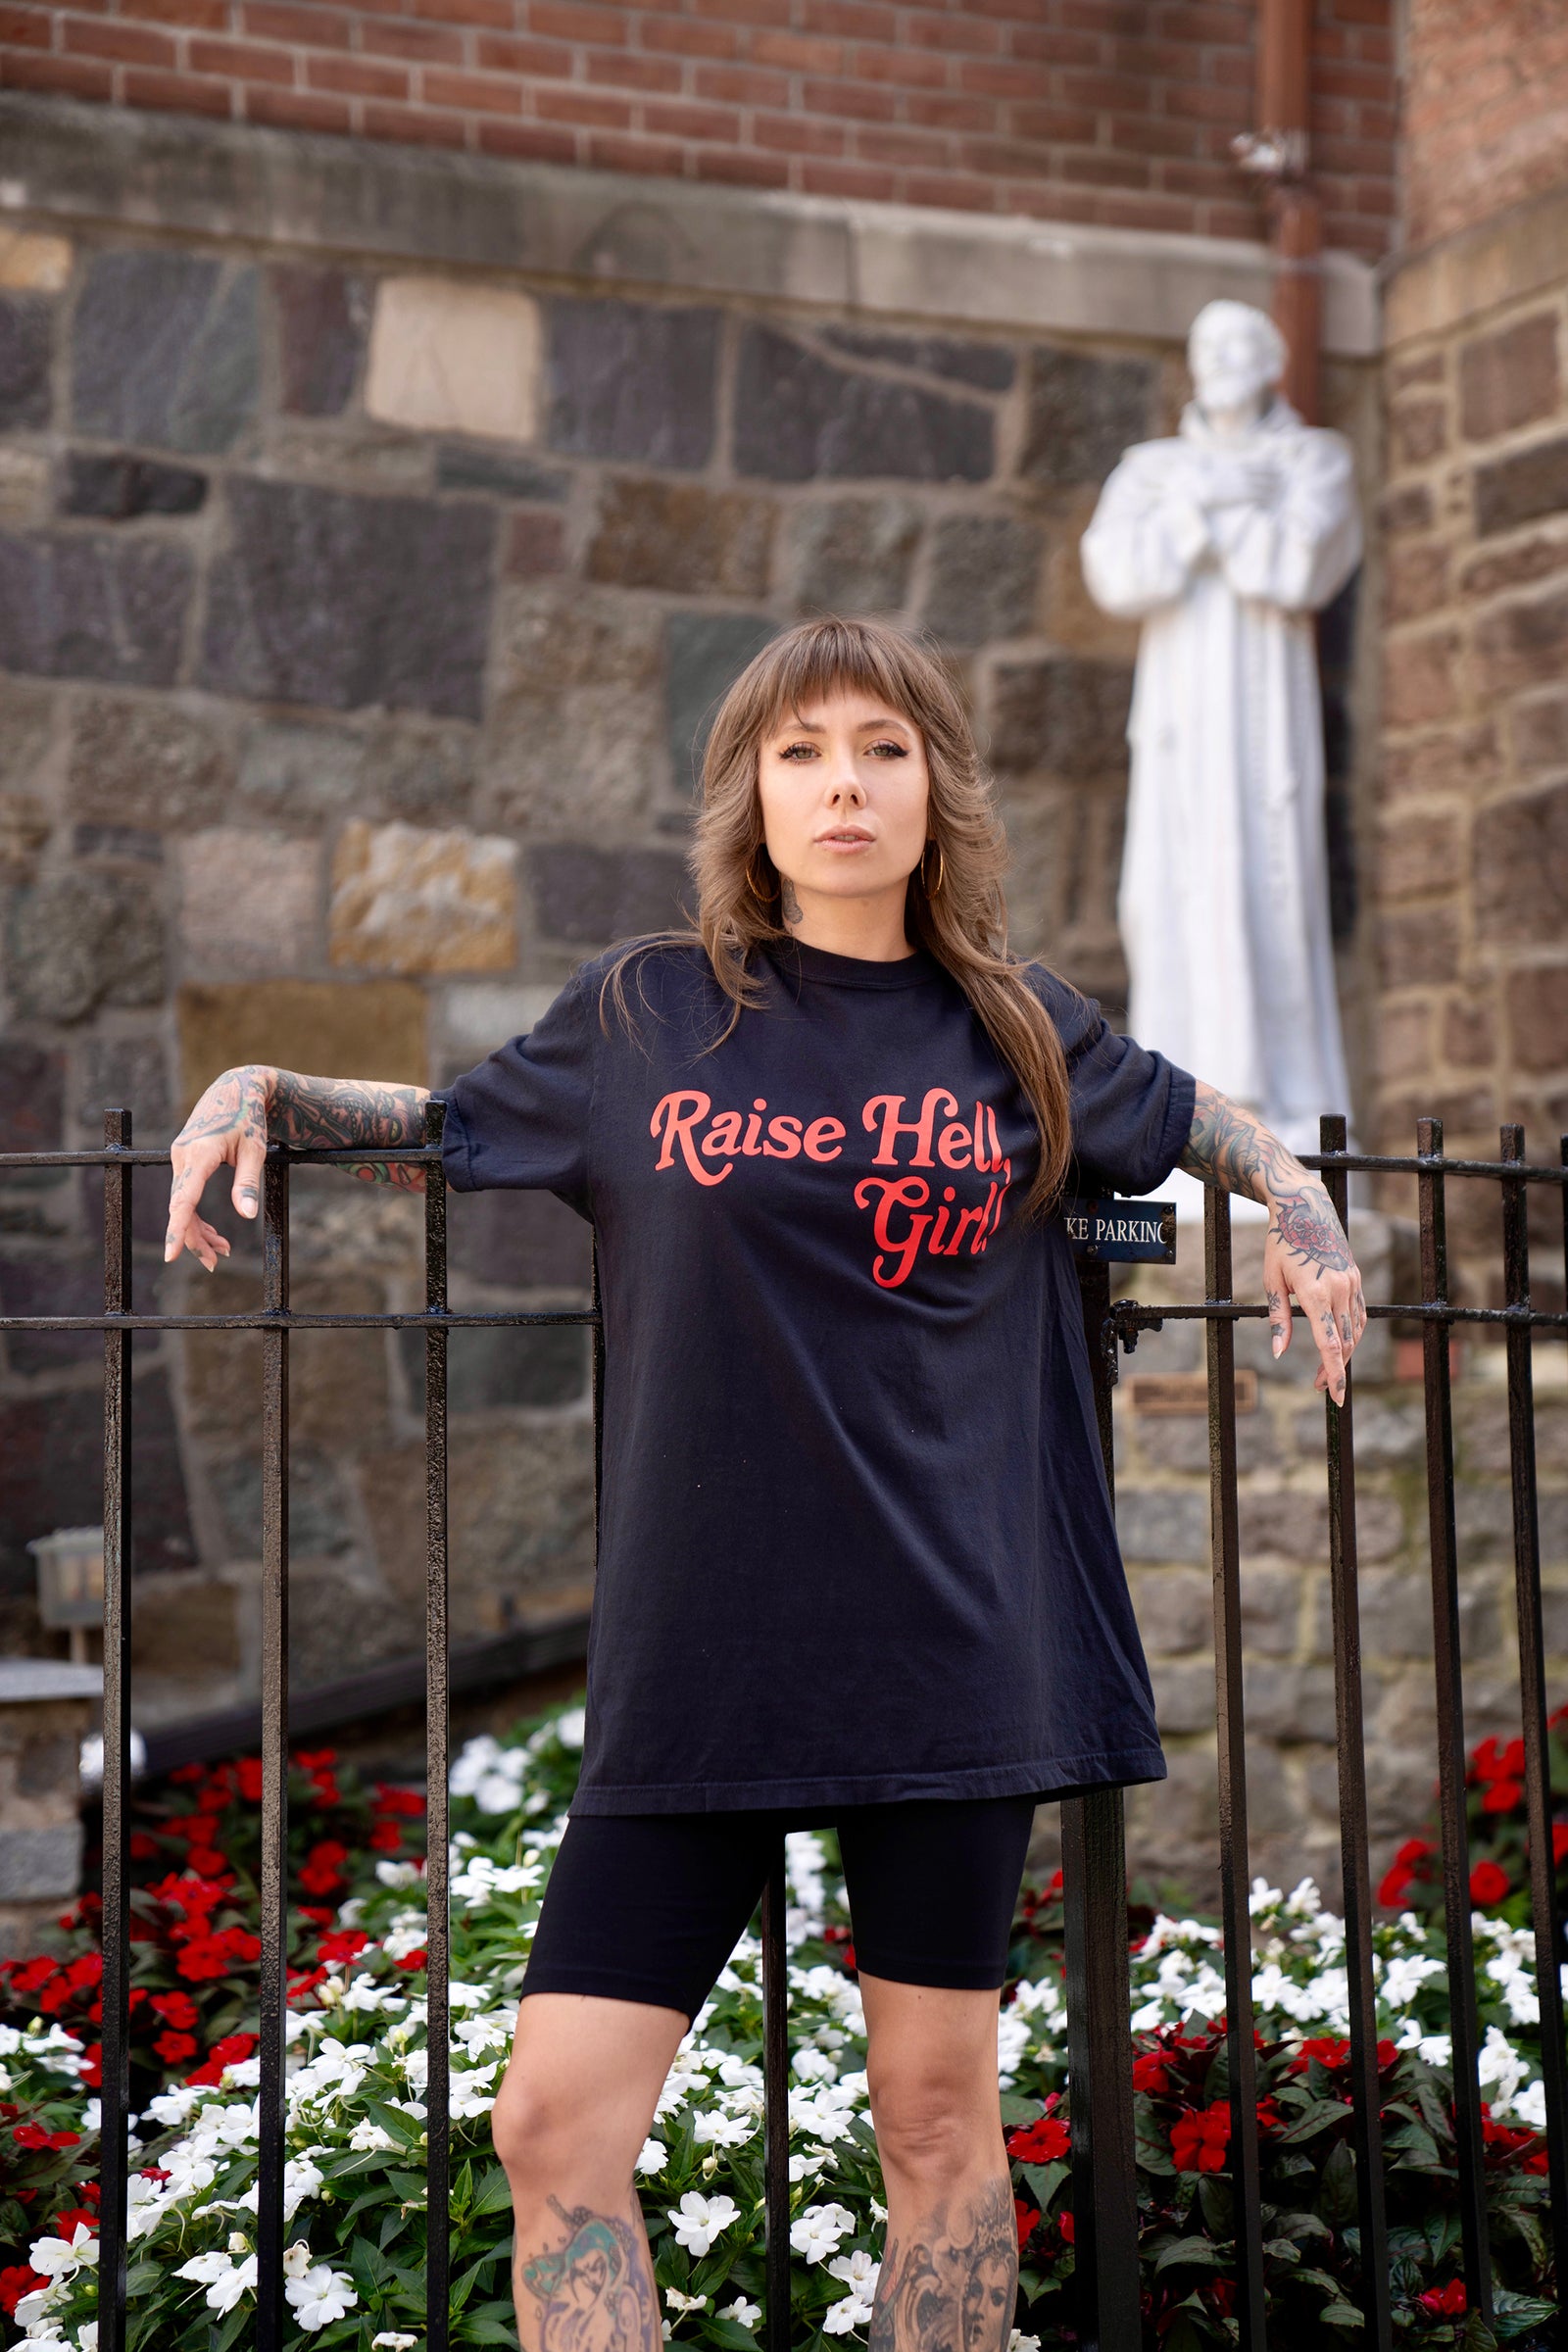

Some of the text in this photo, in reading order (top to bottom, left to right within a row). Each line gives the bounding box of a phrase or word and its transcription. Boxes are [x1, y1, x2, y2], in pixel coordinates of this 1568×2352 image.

[650, 1088, 1011, 1186] Raise Hell,
[1064, 1216, 1089, 1240] KE
